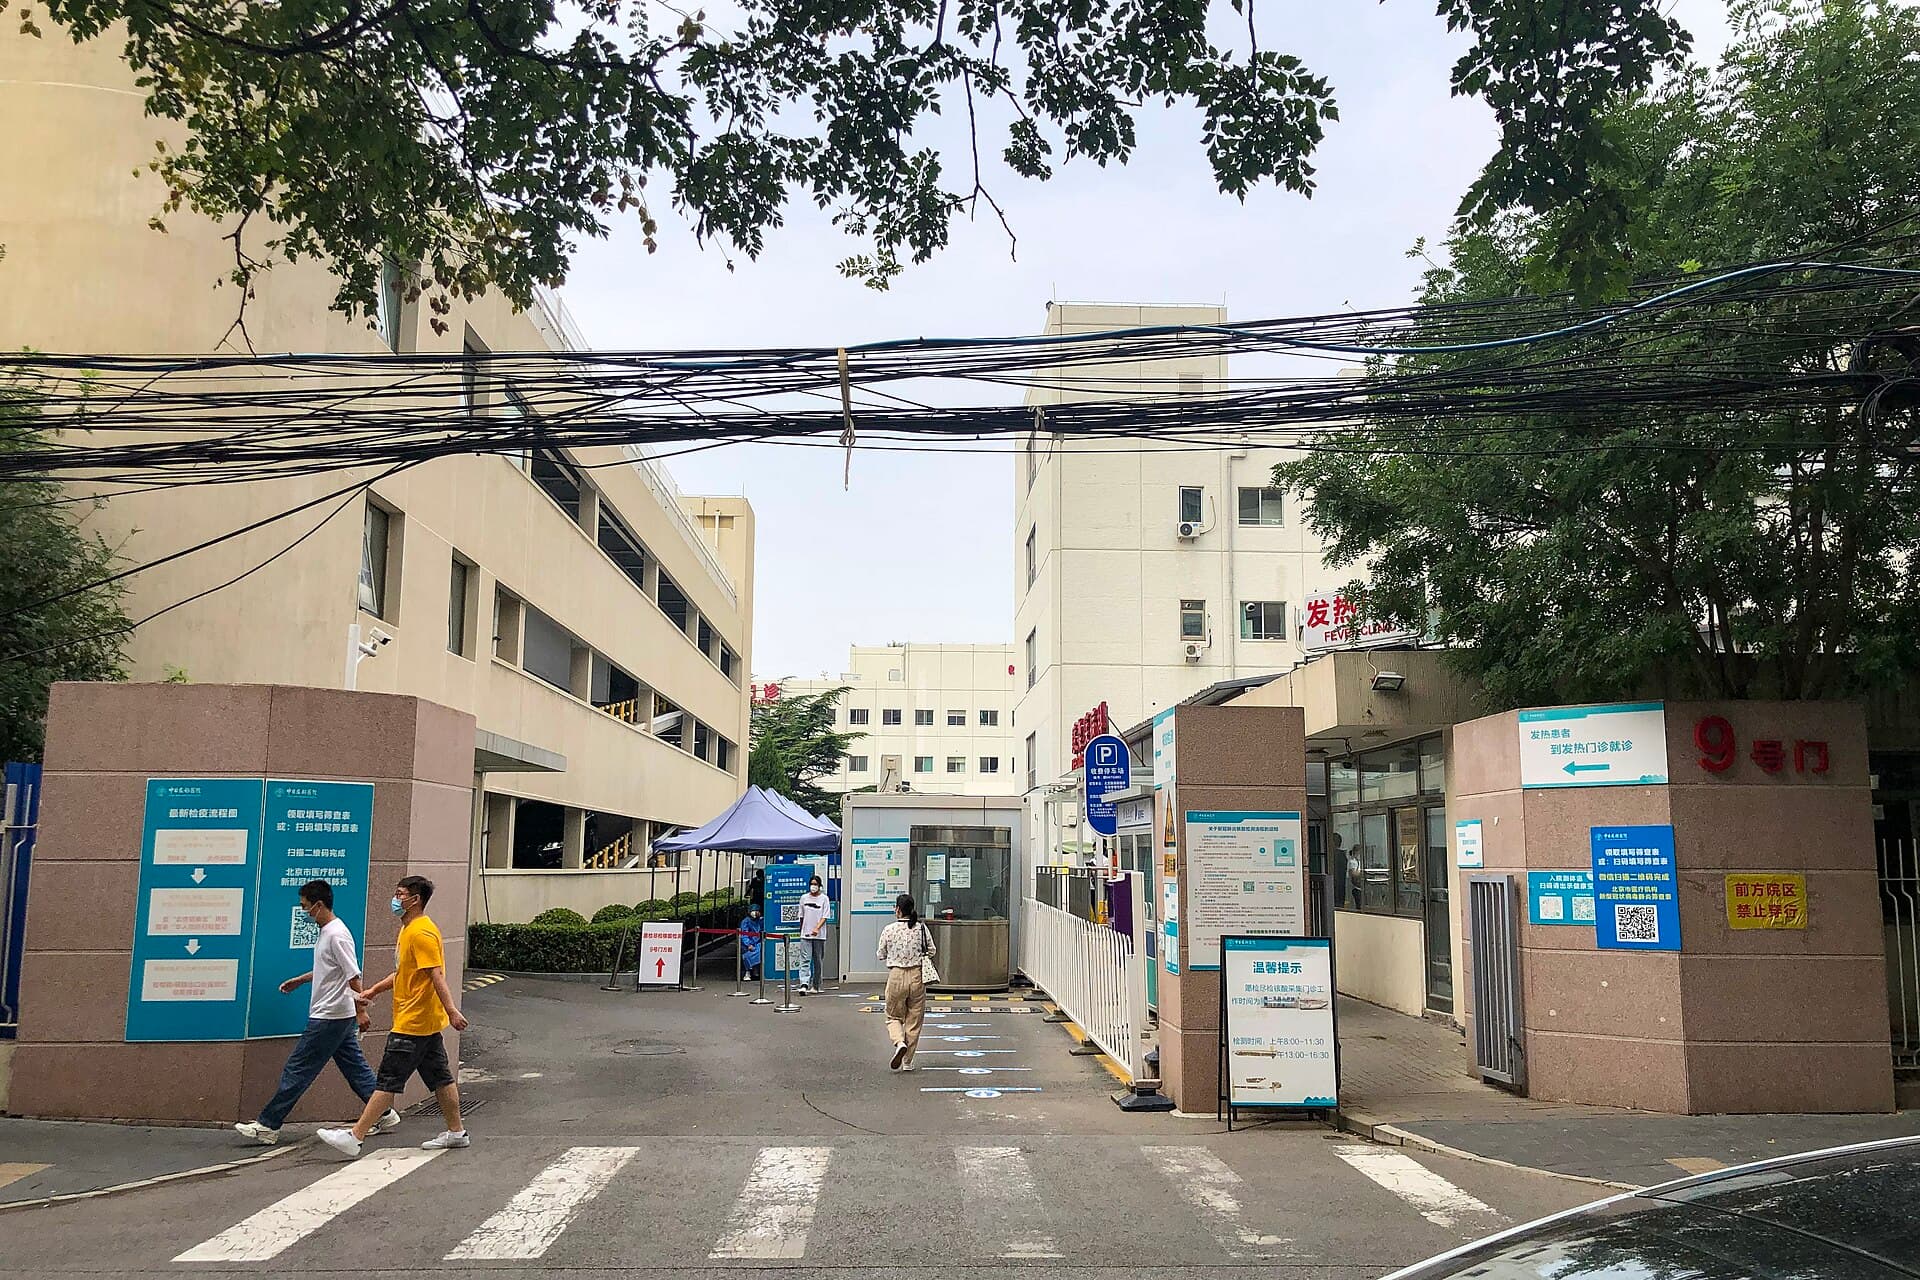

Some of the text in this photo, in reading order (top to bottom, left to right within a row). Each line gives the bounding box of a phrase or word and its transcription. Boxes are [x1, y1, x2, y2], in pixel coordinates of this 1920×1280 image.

[1530, 728, 1571, 740] 发热患者
[1550, 739, 1633, 755] 到发热门诊就诊
[1694, 714, 1829, 775] 9号门
[1100, 746, 1112, 763] P
[285, 867, 345, 877] 北京市医疗机构
[1735, 882, 1797, 897] 前方院区
[1736, 903, 1798, 919] 禁止穿行
[1252, 960, 1303, 975] 温馨提示
[1276, 1050, 1330, 1059] 午13:00-16:30
